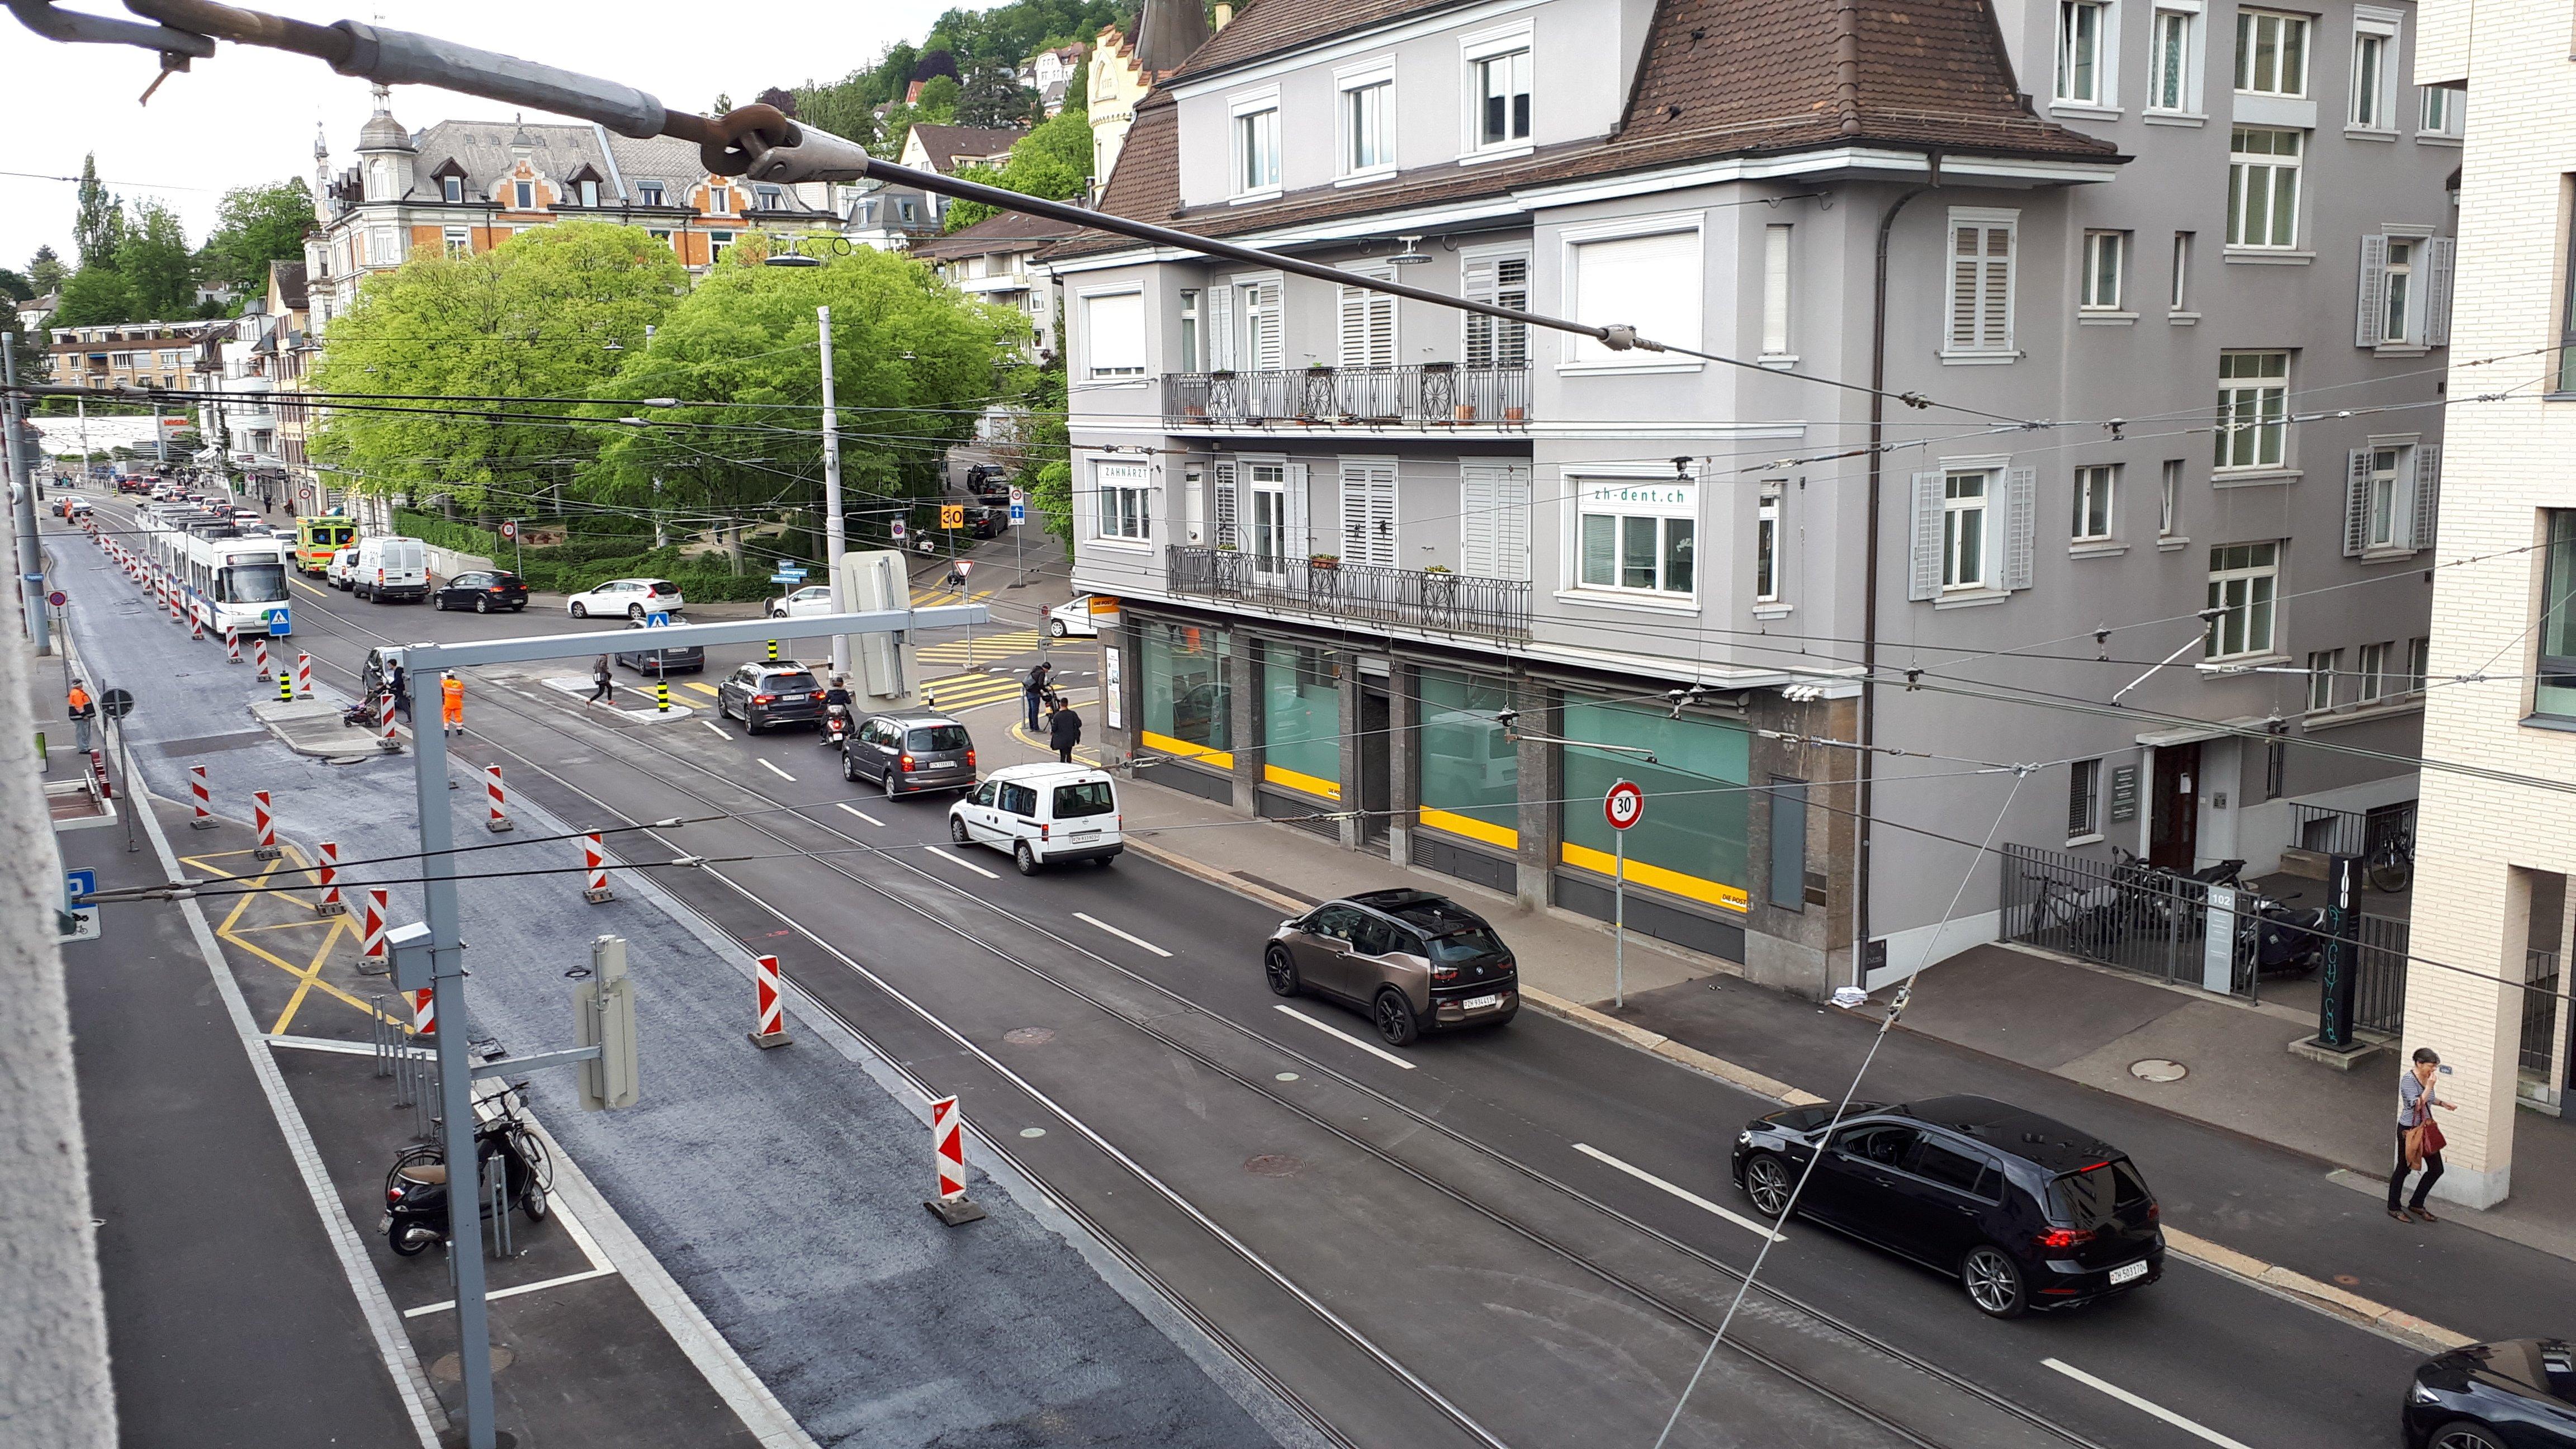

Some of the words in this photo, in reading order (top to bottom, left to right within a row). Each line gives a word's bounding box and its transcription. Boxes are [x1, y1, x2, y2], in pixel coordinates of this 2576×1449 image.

[1595, 487, 1683, 503] zh-dent.ch
[943, 510, 962, 523] 30
[1617, 797, 1631, 814] 30
[2340, 859, 2350, 910] 100
[1732, 896, 1746, 906] POST
[2213, 893, 2231, 906] 102
[2114, 1270, 2122, 1281] ZH
